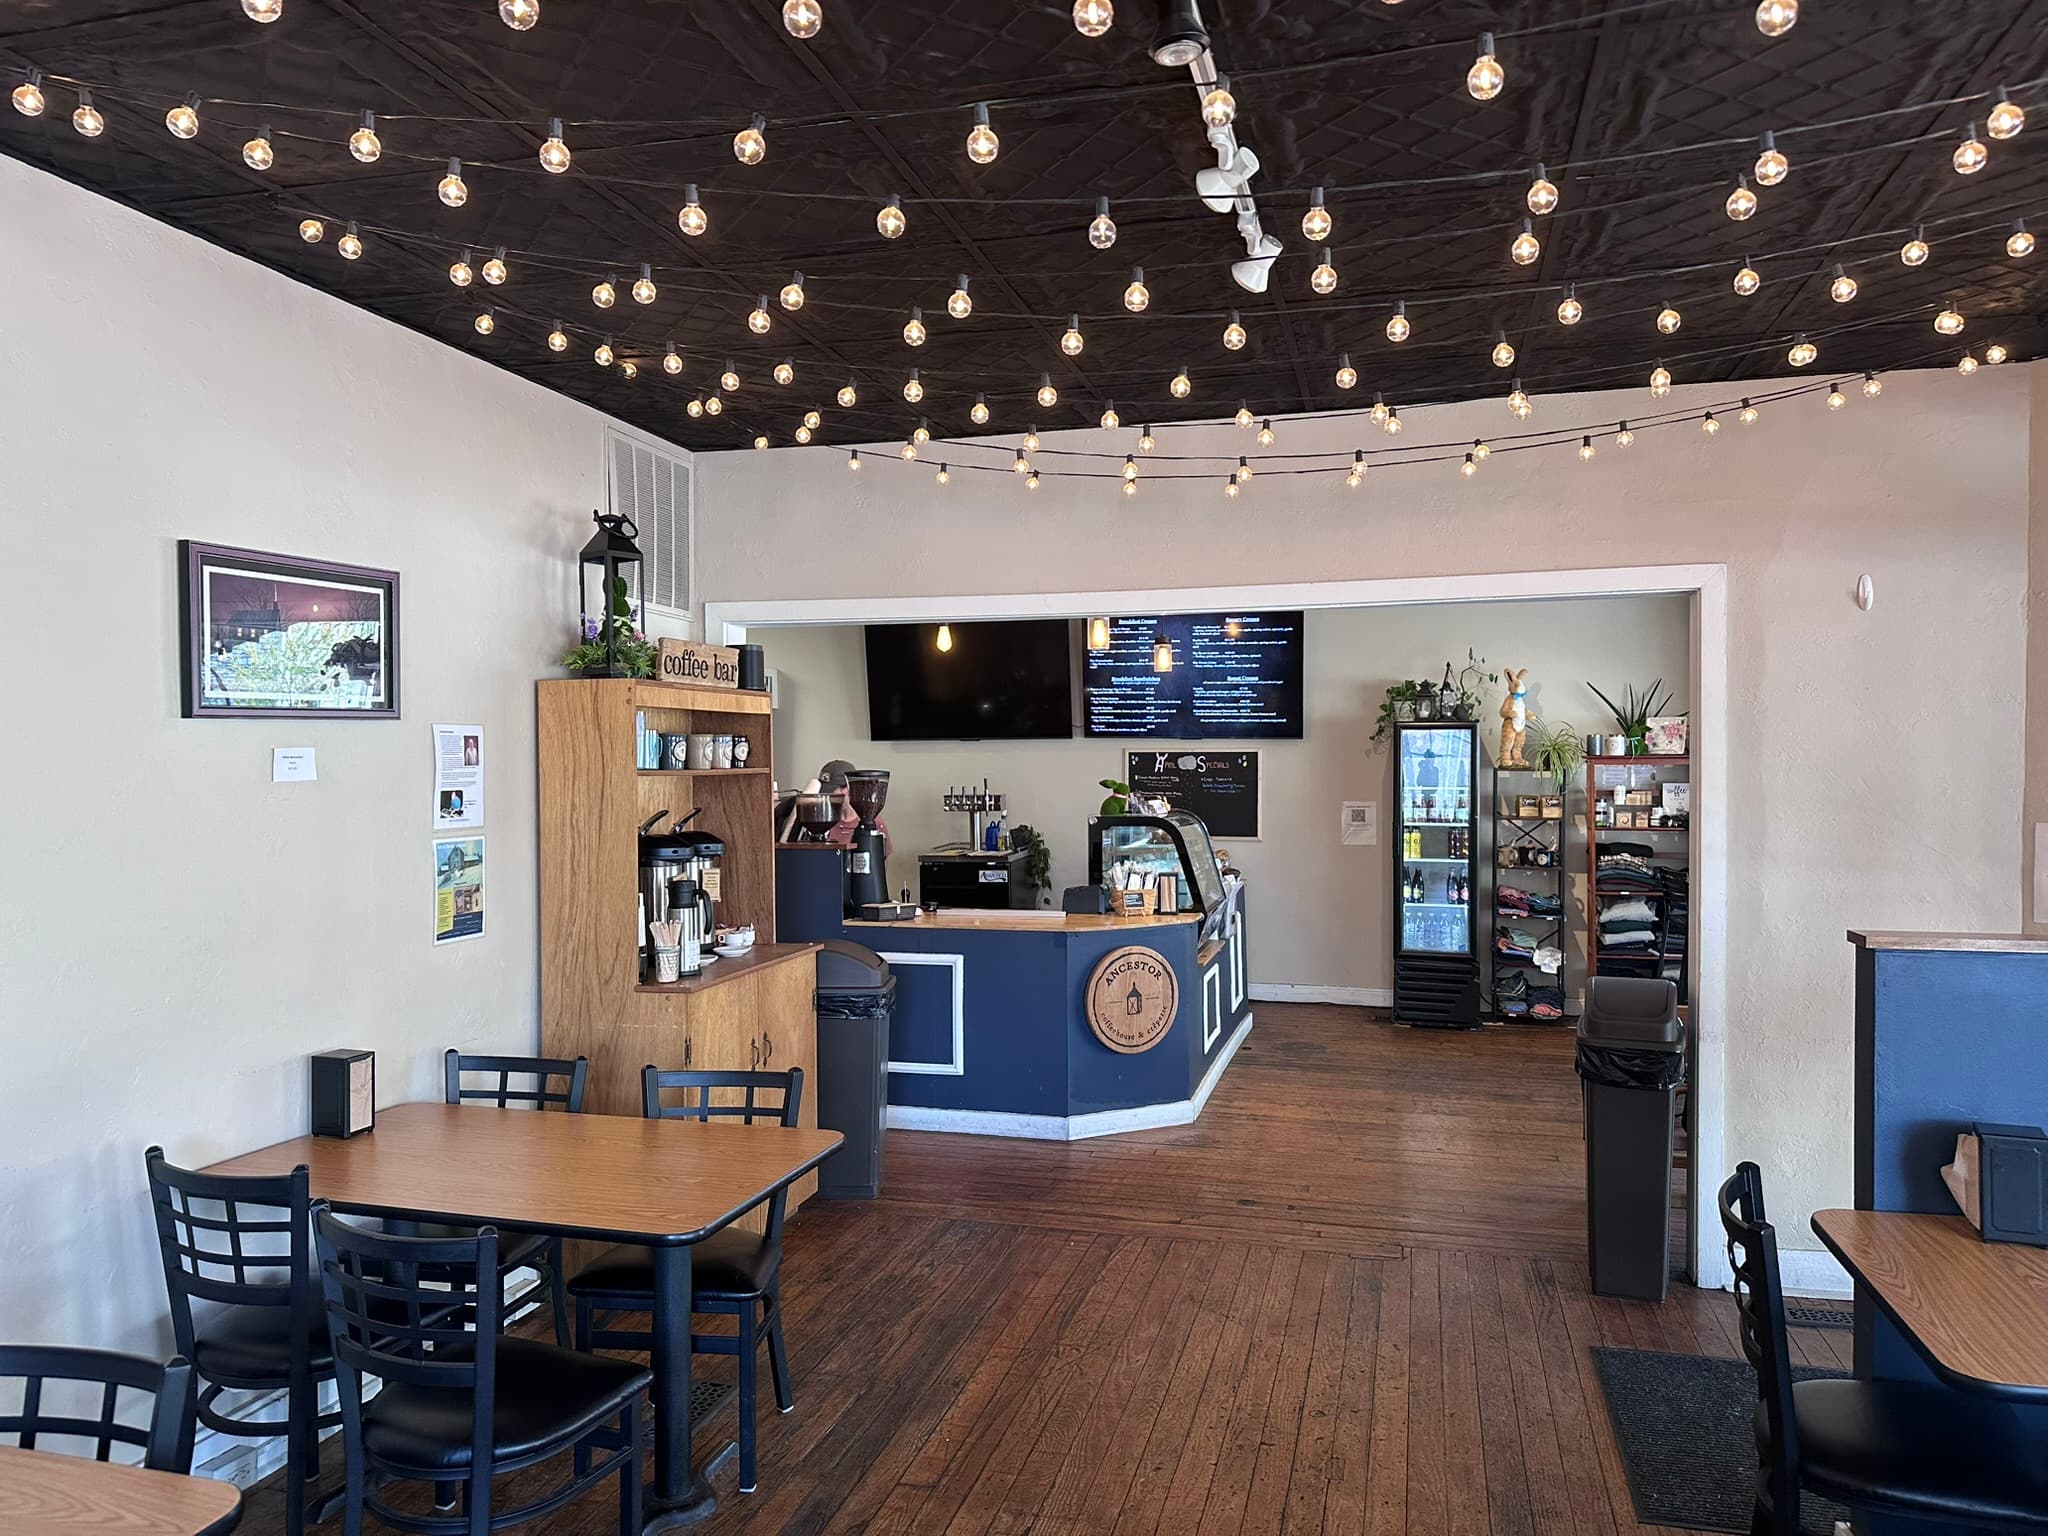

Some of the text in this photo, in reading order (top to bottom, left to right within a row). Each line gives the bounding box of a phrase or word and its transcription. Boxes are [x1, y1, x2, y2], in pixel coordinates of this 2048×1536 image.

[664, 649, 738, 682] coffee bar
[1105, 961, 1162, 987] ANCESTOR
[1101, 1012, 1135, 1041] coffeehouse
[1138, 1031, 1144, 1039] &
